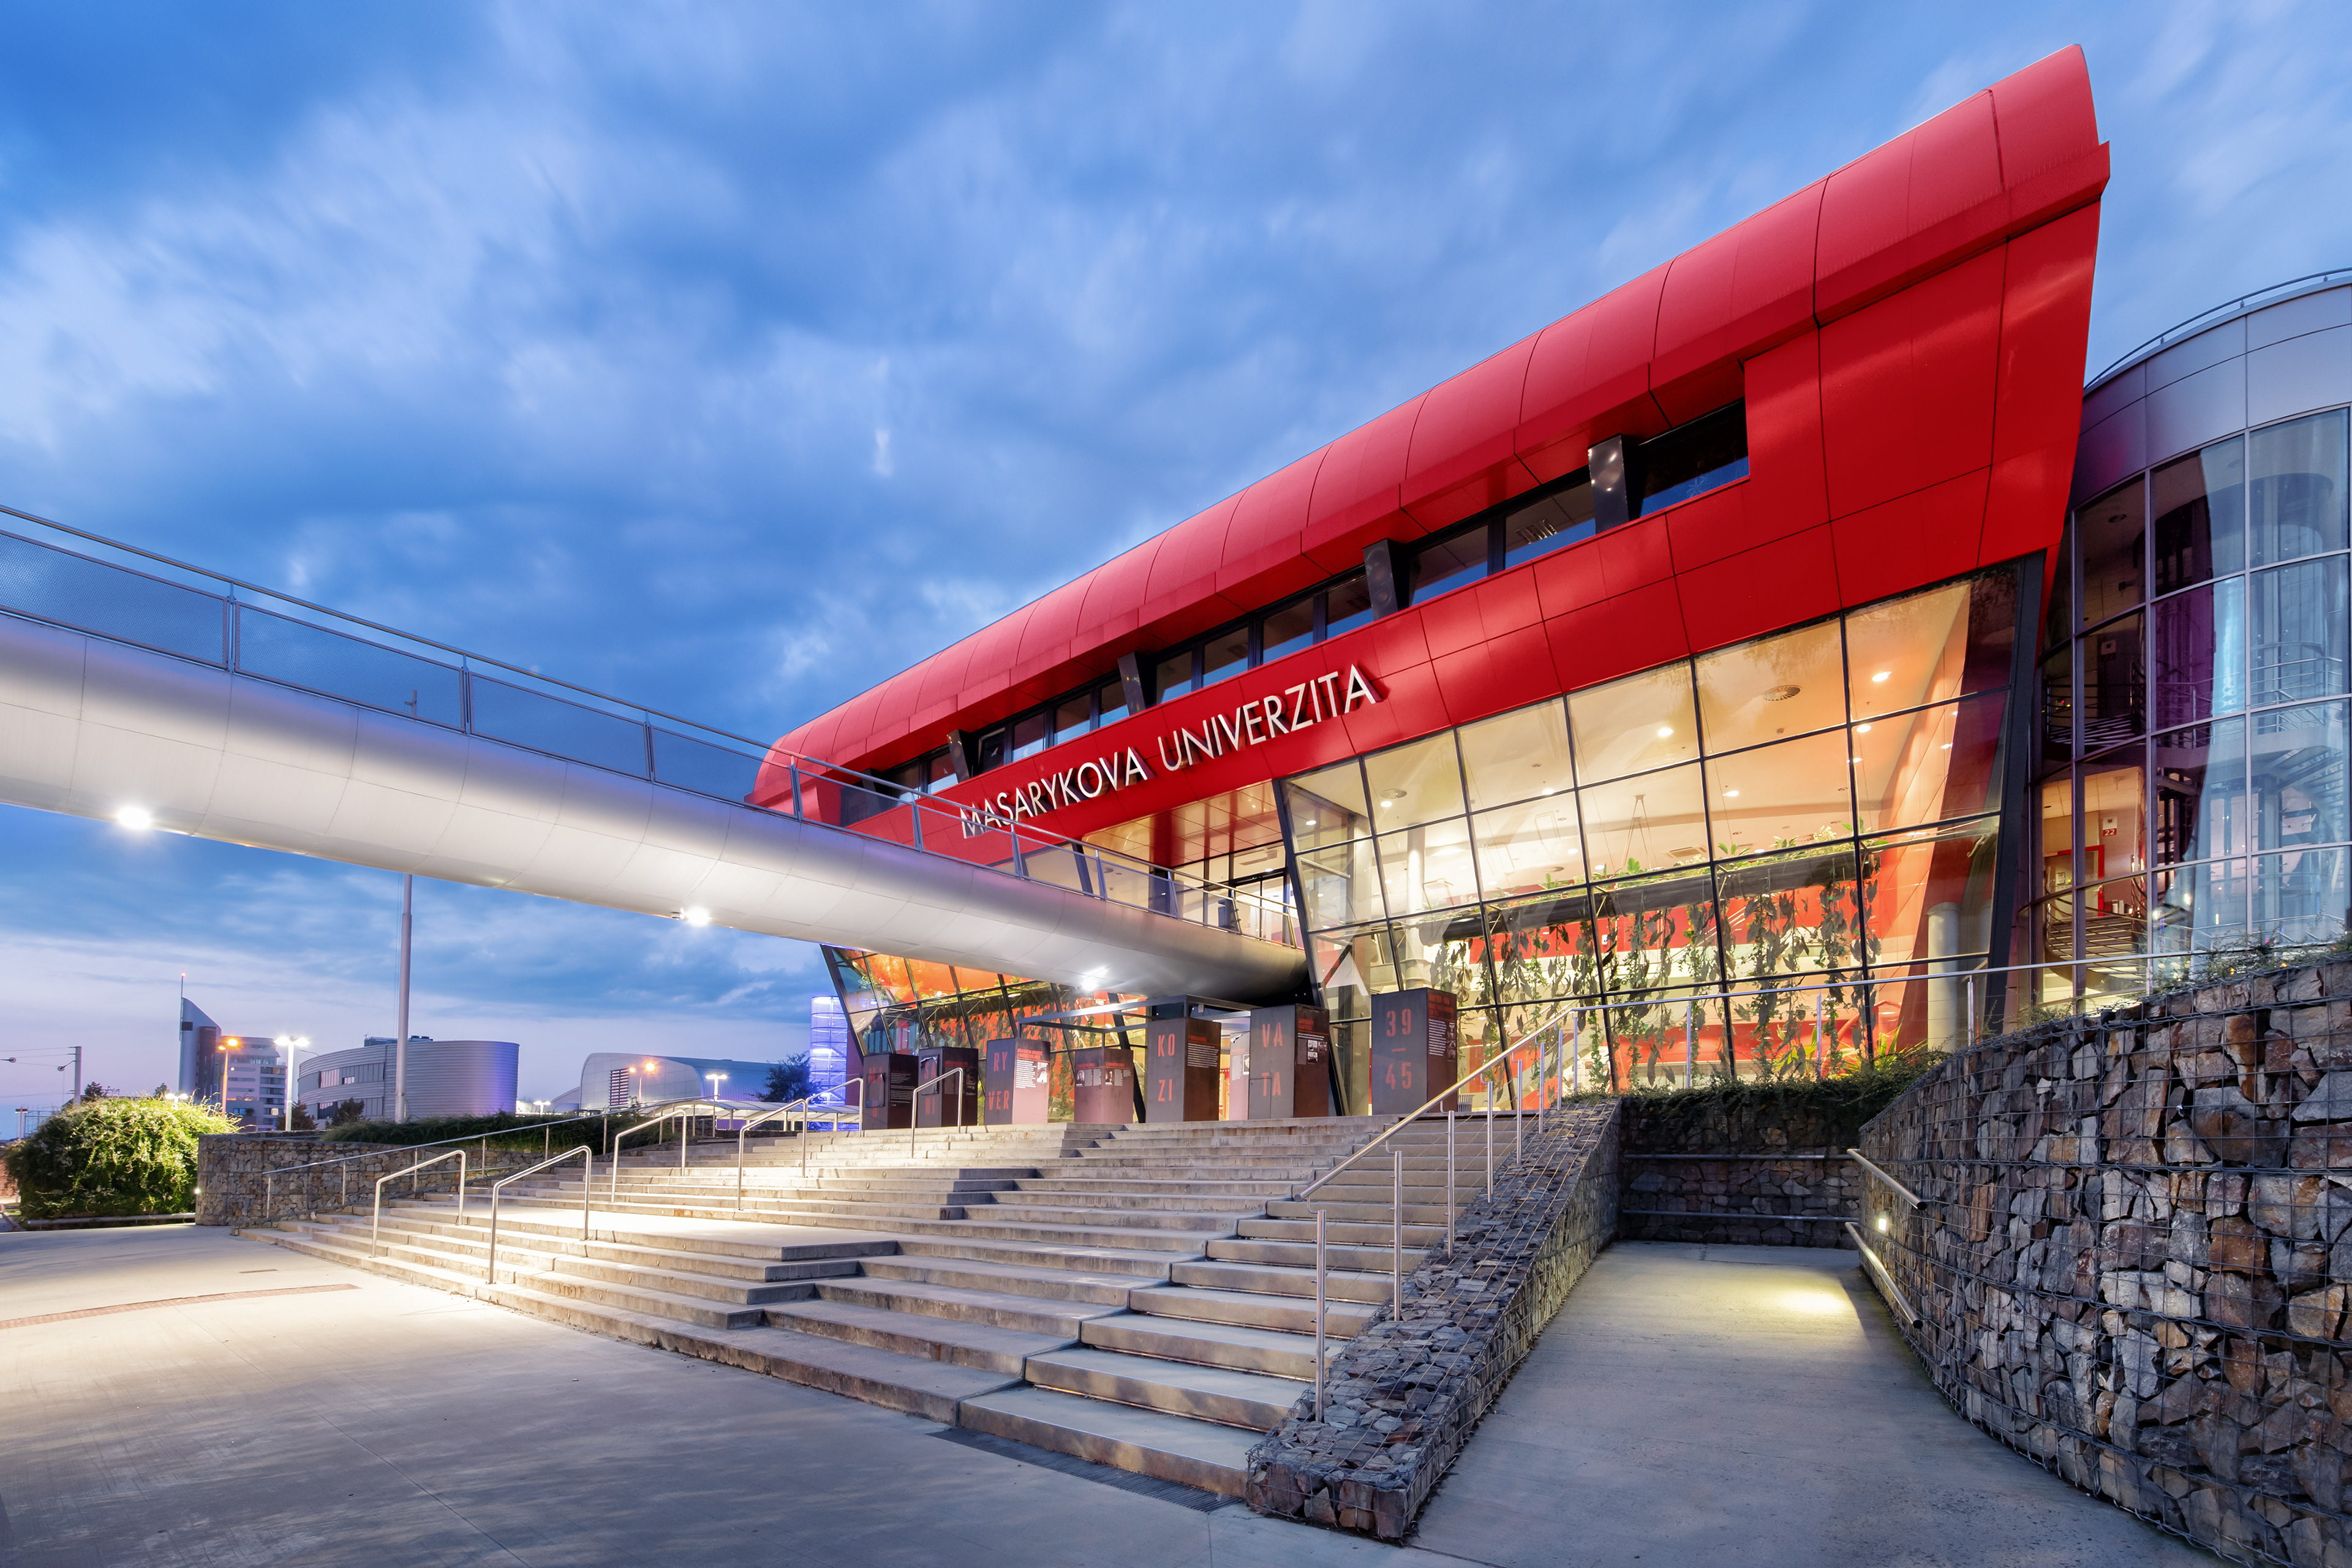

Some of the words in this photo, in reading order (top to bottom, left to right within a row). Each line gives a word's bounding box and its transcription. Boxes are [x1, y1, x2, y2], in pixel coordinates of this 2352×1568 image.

[960, 746, 1148, 839] MASARYKOVA
[1157, 664, 1376, 771] UNIVERZITA
[1386, 1008, 1412, 1037] 39
[1158, 1033, 1175, 1057] KO
[1262, 1022, 1283, 1047] VA
[924, 1061, 937, 1079] SA
[993, 1051, 1008, 1072] RY
[868, 1066, 883, 1084] MA
[1262, 1071, 1281, 1096] TA
[1385, 1062, 1412, 1090] 45
[989, 1090, 1009, 1110] VER
[1158, 1079, 1172, 1102] ZI
[872, 1100, 878, 1117] U
[925, 1096, 935, 1115] NI
